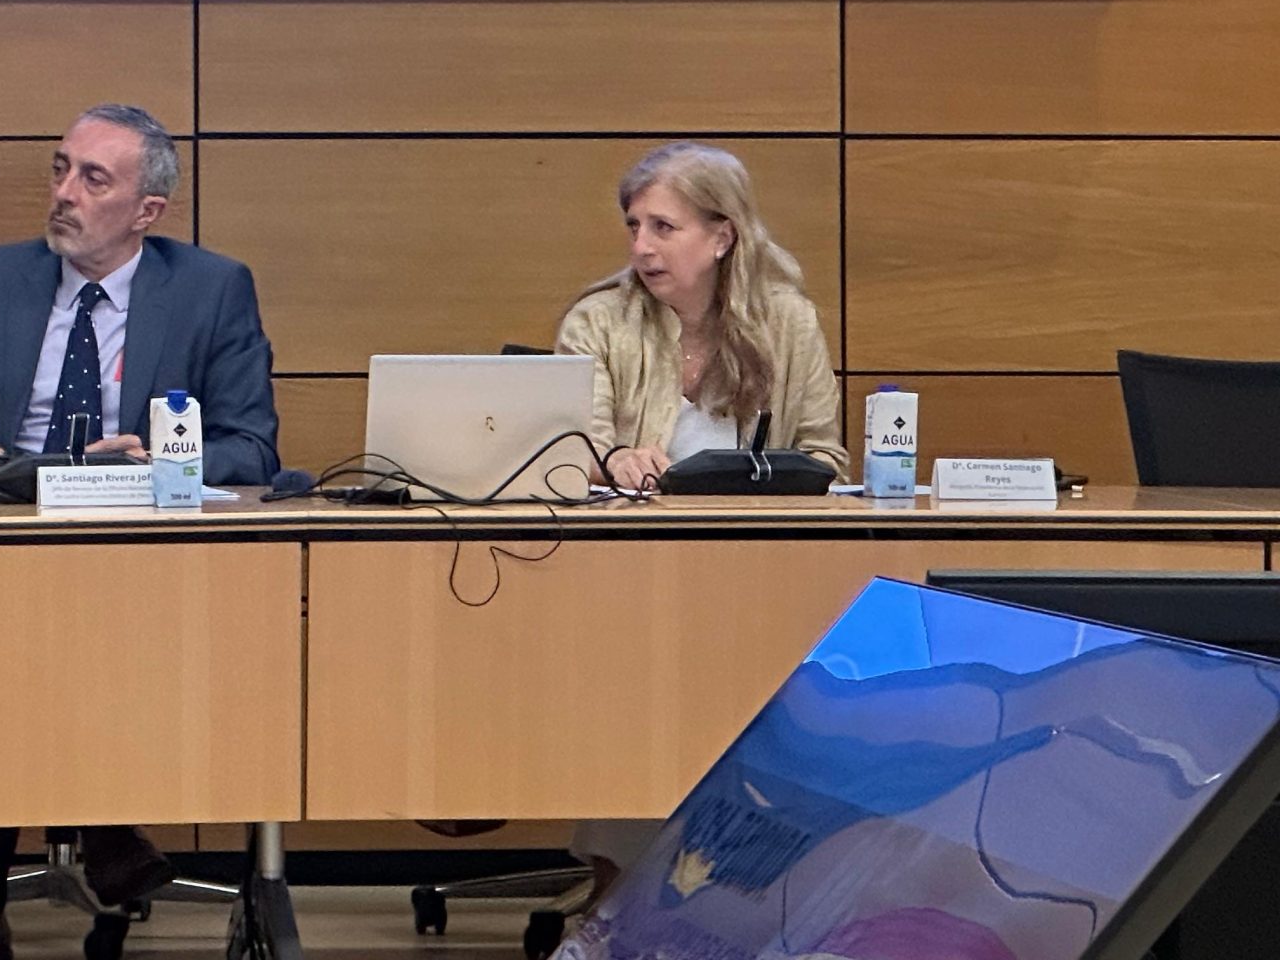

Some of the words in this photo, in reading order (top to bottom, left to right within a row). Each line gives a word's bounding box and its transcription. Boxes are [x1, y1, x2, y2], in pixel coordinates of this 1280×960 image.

[881, 434, 914, 446] AGUA
[161, 442, 198, 454] AGUA
[966, 462, 1001, 471] Carmen
[1003, 463, 1042, 474] Santiago
[61, 474, 103, 484] Santiago
[105, 474, 136, 482] Rivera
[985, 475, 1012, 485] Reyes
